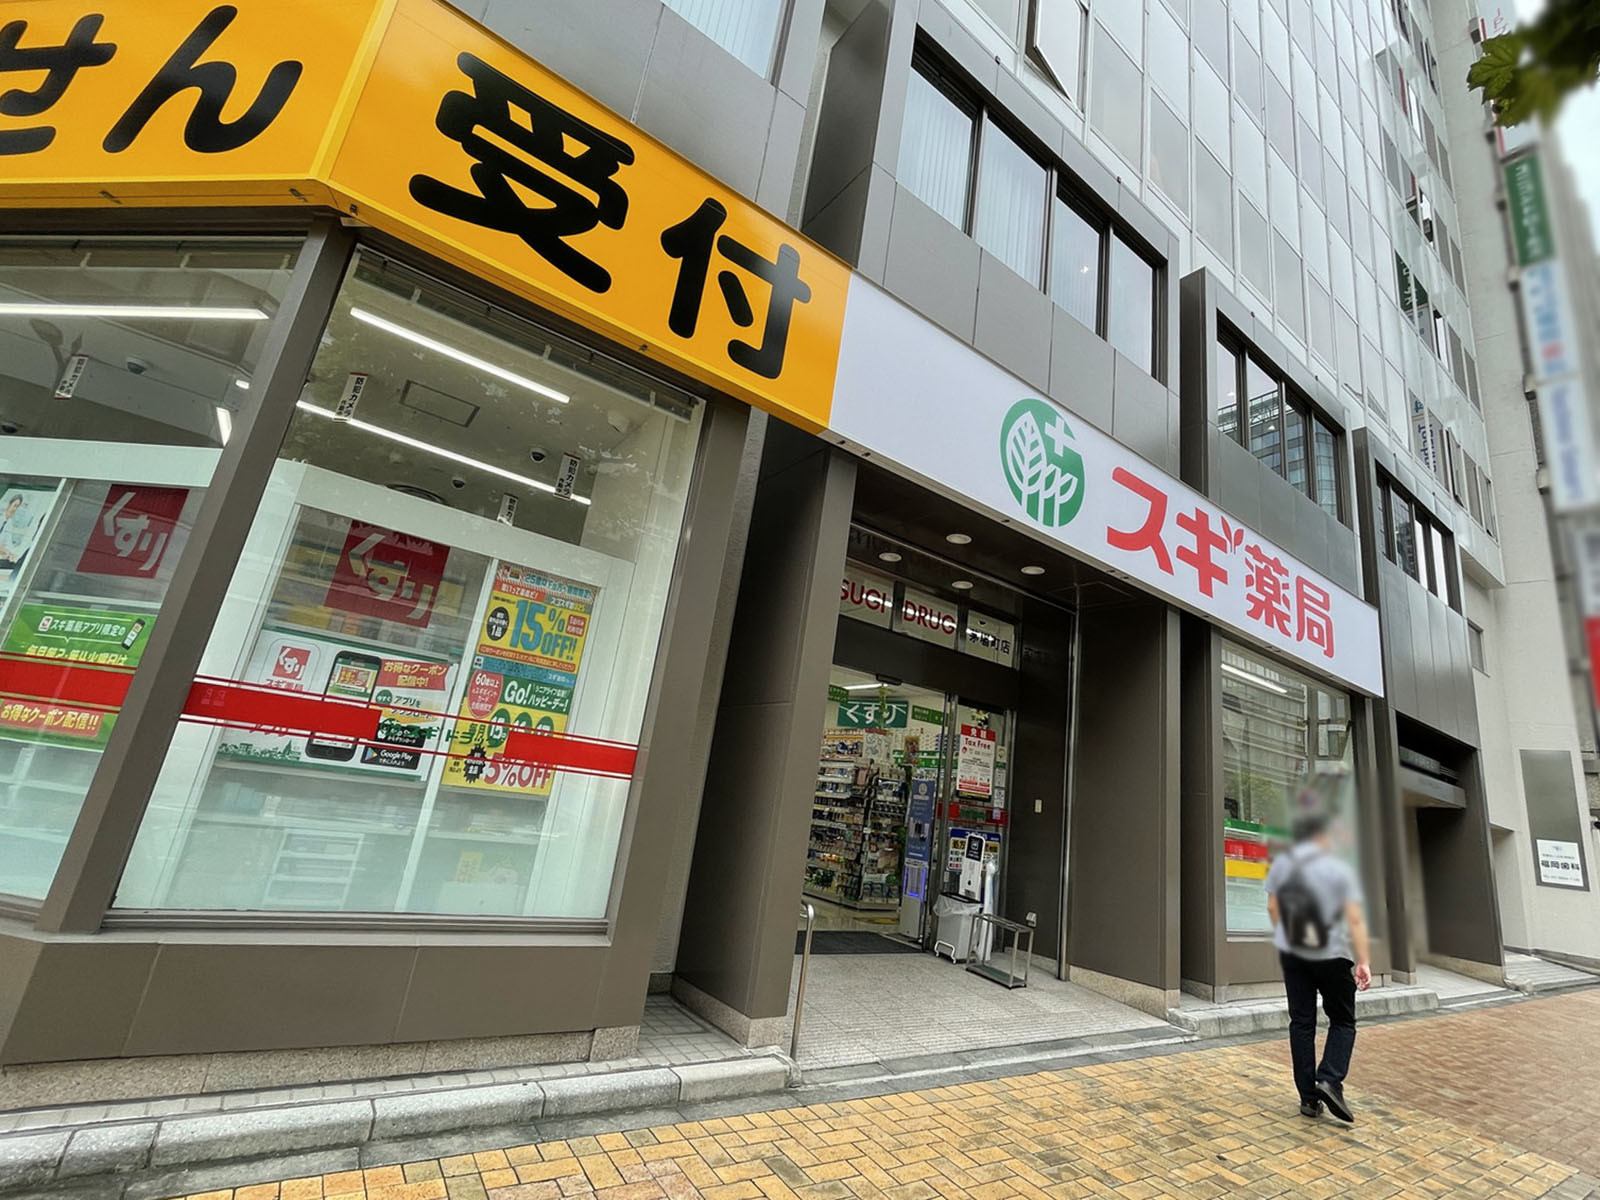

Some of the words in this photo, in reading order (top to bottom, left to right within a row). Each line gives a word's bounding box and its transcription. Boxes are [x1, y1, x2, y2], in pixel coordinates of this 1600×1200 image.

[407, 51, 811, 380] 受付
[103, 491, 169, 571] くすり
[348, 532, 434, 620] くすり
[1107, 466, 1335, 659] スギ薬局
[841, 578, 887, 614] SUGI
[903, 600, 957, 635] DRUG
[279, 647, 306, 679] くすり
[1, 703, 100, 731] お得なクーポン配信!!
[504, 680, 532, 705] Go!
[380, 749, 402, 760] Google
